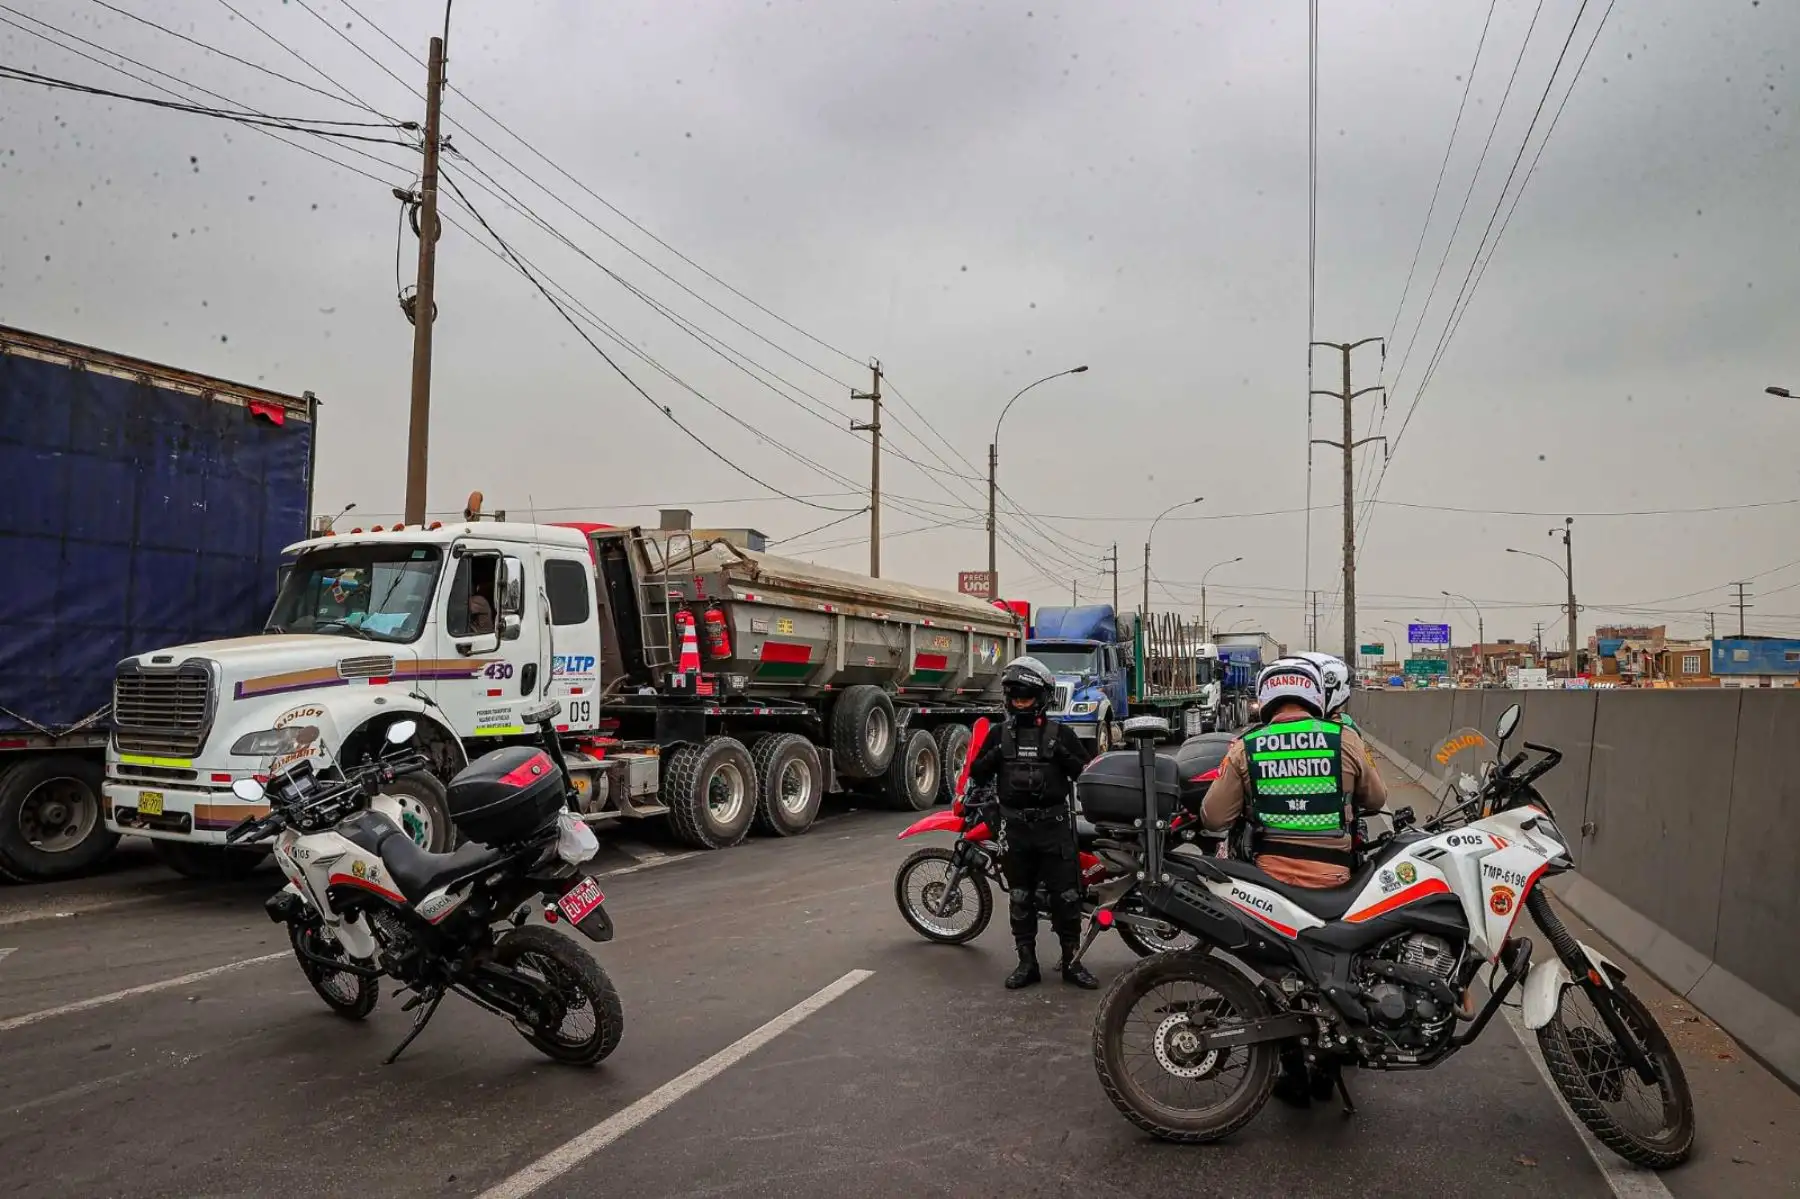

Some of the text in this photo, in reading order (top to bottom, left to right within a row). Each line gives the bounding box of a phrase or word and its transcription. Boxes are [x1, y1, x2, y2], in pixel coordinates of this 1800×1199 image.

[484, 663, 513, 679] 430
[566, 656, 595, 672] LTP
[1263, 676, 1311, 690] TRANSITO
[569, 700, 590, 722] 09
[1256, 732, 1328, 752] POLICIA
[1258, 758, 1331, 778] TRANSITO
[1461, 835, 1483, 845] 105
[1483, 864, 1526, 887] TMP-6196
[565, 884, 600, 918] EU-7800
[1231, 887, 1274, 913] POLICÍA
